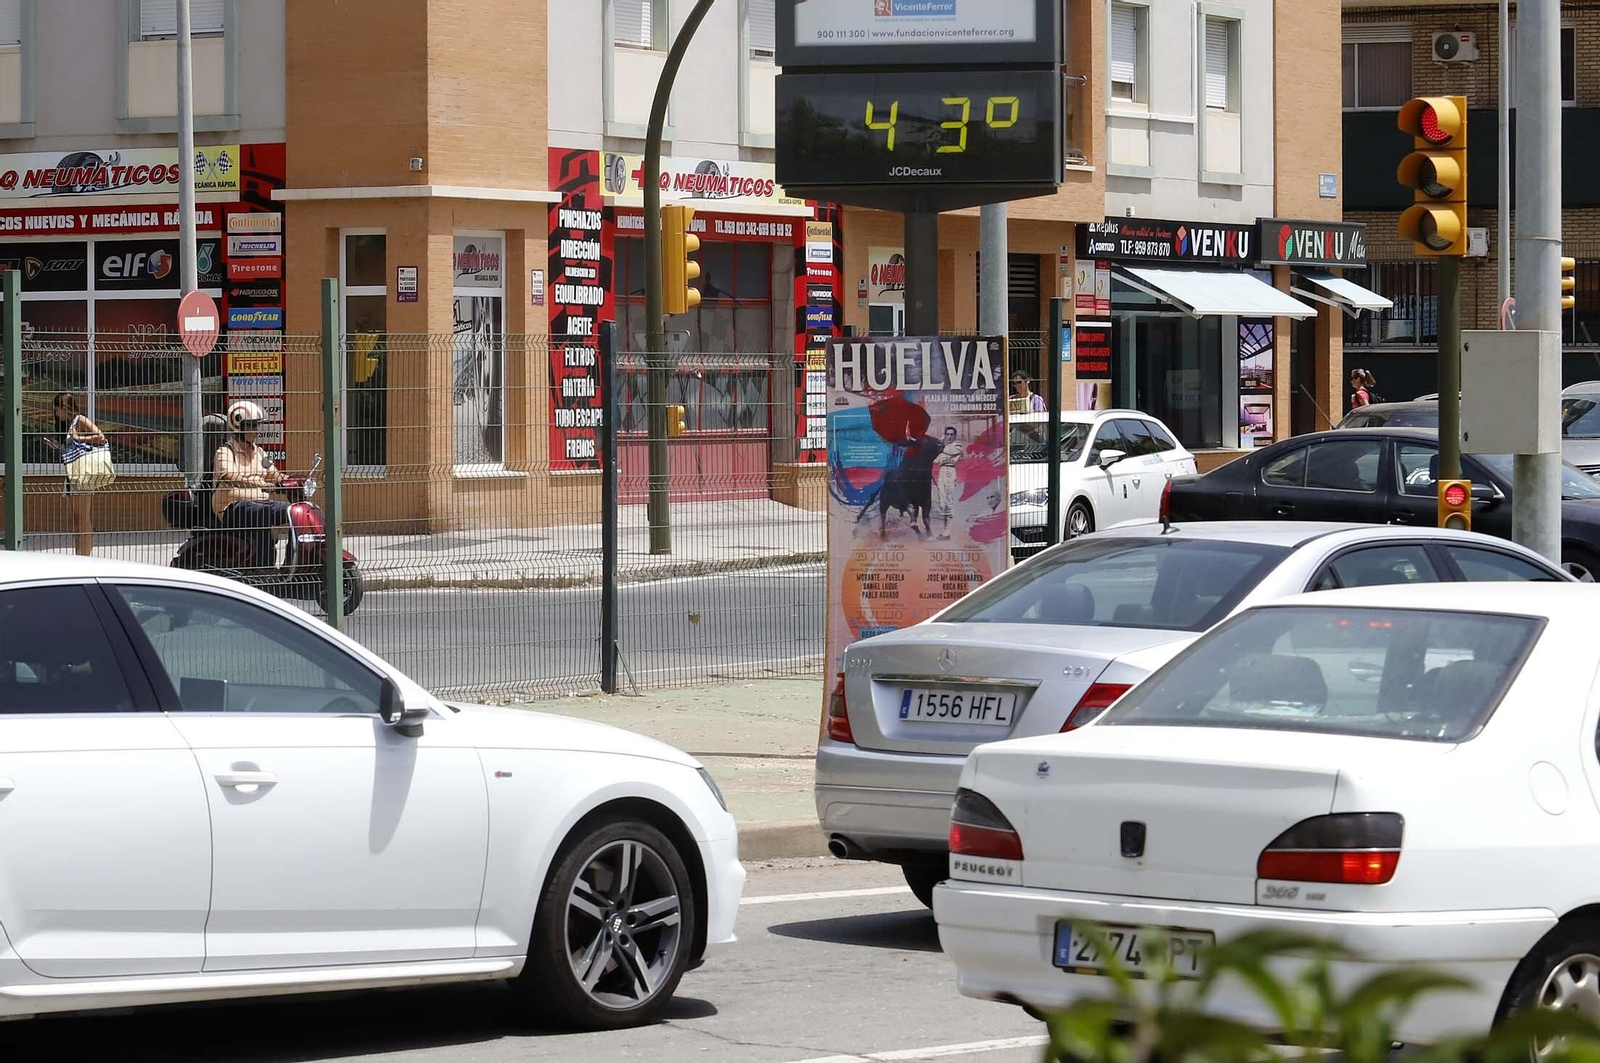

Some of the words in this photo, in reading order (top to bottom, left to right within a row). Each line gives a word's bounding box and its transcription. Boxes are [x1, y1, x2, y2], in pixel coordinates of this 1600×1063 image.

[895, 3, 953, 11] VicenteFerrer
[817, 30, 834, 39] 900
[837, 30, 847, 38] 111
[849, 30, 865, 38] 300
[872, 28, 1014, 38] www.fundacionvicenteferrer.org
[22, 160, 180, 190] NEUMÁTICOS
[889, 167, 942, 176] JCDecaux
[195, 180, 217, 189] ECÁNICA
[217, 180, 237, 188] RÁPIDA
[673, 172, 775, 197] NEUMÁTICOS
[25, 214, 74, 229] NUEVOS
[79, 214, 88, 227] Y
[92, 210, 159, 228] MECÁNICA
[229, 217, 279, 229] Continental
[559, 208, 602, 230] PINCHAZOS
[807, 226, 831, 237] Continental
[560, 239, 600, 260] DIRECCIÓN
[1135, 241, 1146, 254] 959
[1147, 242, 1158, 255] 873
[1159, 243, 1170, 256] 870
[1191, 228, 1249, 259] VENKU
[1294, 230, 1344, 260] VENKU
[103, 253, 146, 277] elf
[232, 264, 278, 273] Firestone
[807, 267, 832, 276] Firestone
[555, 284, 604, 306] EQUILIBRADO
[231, 311, 279, 323] GOODYEAR
[807, 312, 832, 322] GOODYEAR
[567, 317, 592, 336] ACEITE
[232, 356, 278, 370] PIRELLI
[565, 347, 595, 367] FILTROS
[833, 341, 996, 391] HUELVA
[563, 376, 595, 397] BATERÍA
[555, 408, 575, 427] TUBO
[566, 439, 595, 458] FRENOS
[946, 552, 980, 562] JULIO
[949, 573, 983, 581] MANZANARES
[862, 591, 878, 599] PABLO
[917, 694, 963, 718] 1556
[969, 697, 1006, 720] HFL
[954, 861, 1013, 877] PEUGEOT
